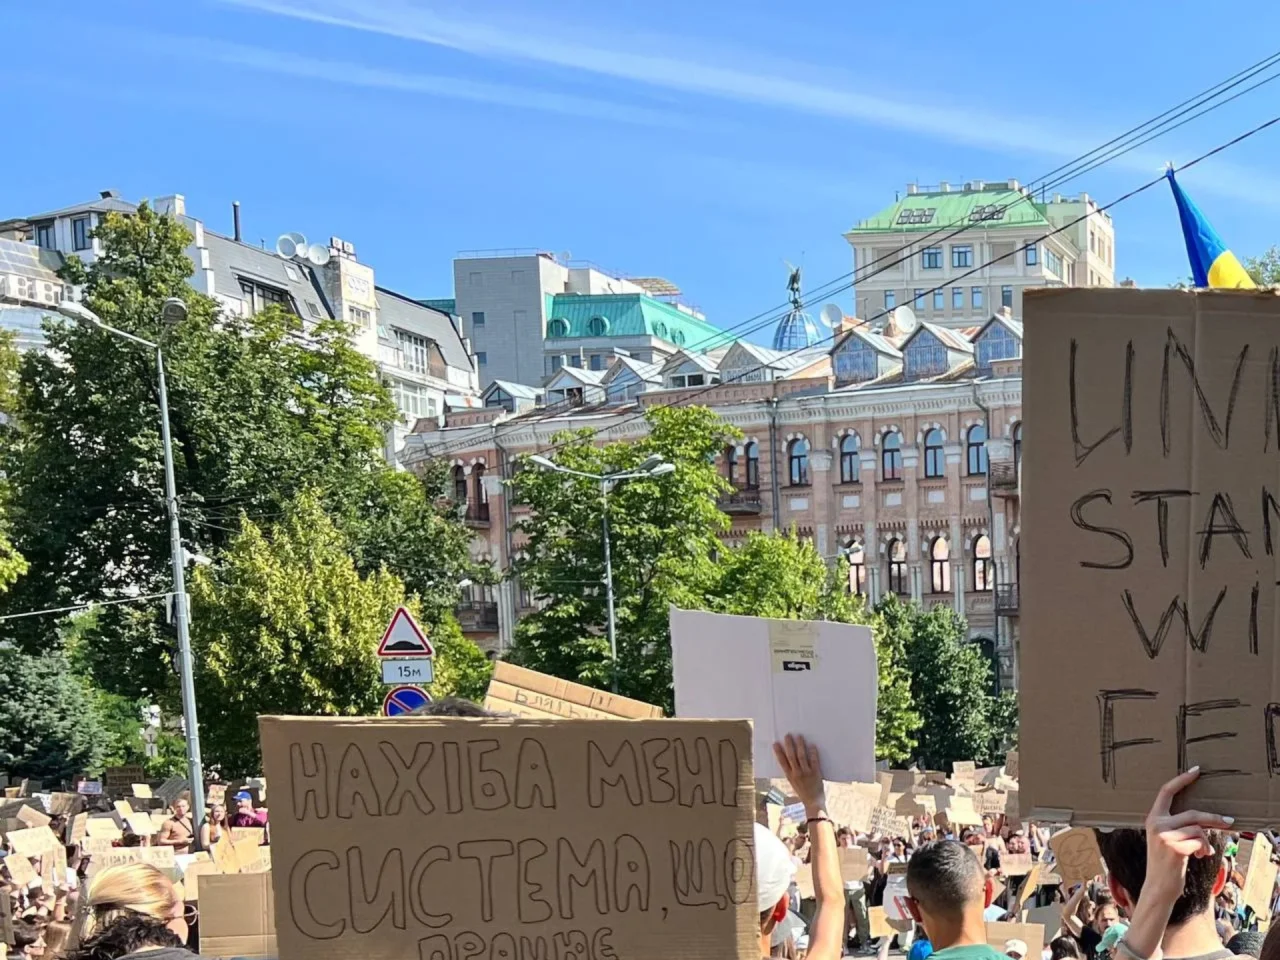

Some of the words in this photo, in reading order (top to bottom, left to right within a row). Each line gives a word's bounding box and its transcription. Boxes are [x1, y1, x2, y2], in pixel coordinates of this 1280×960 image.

[290, 736, 557, 821] НАХІБА
[586, 735, 741, 809] МЕНІ
[289, 832, 670, 940] СИСТЕМА,
[670, 834, 756, 912] ЩО
